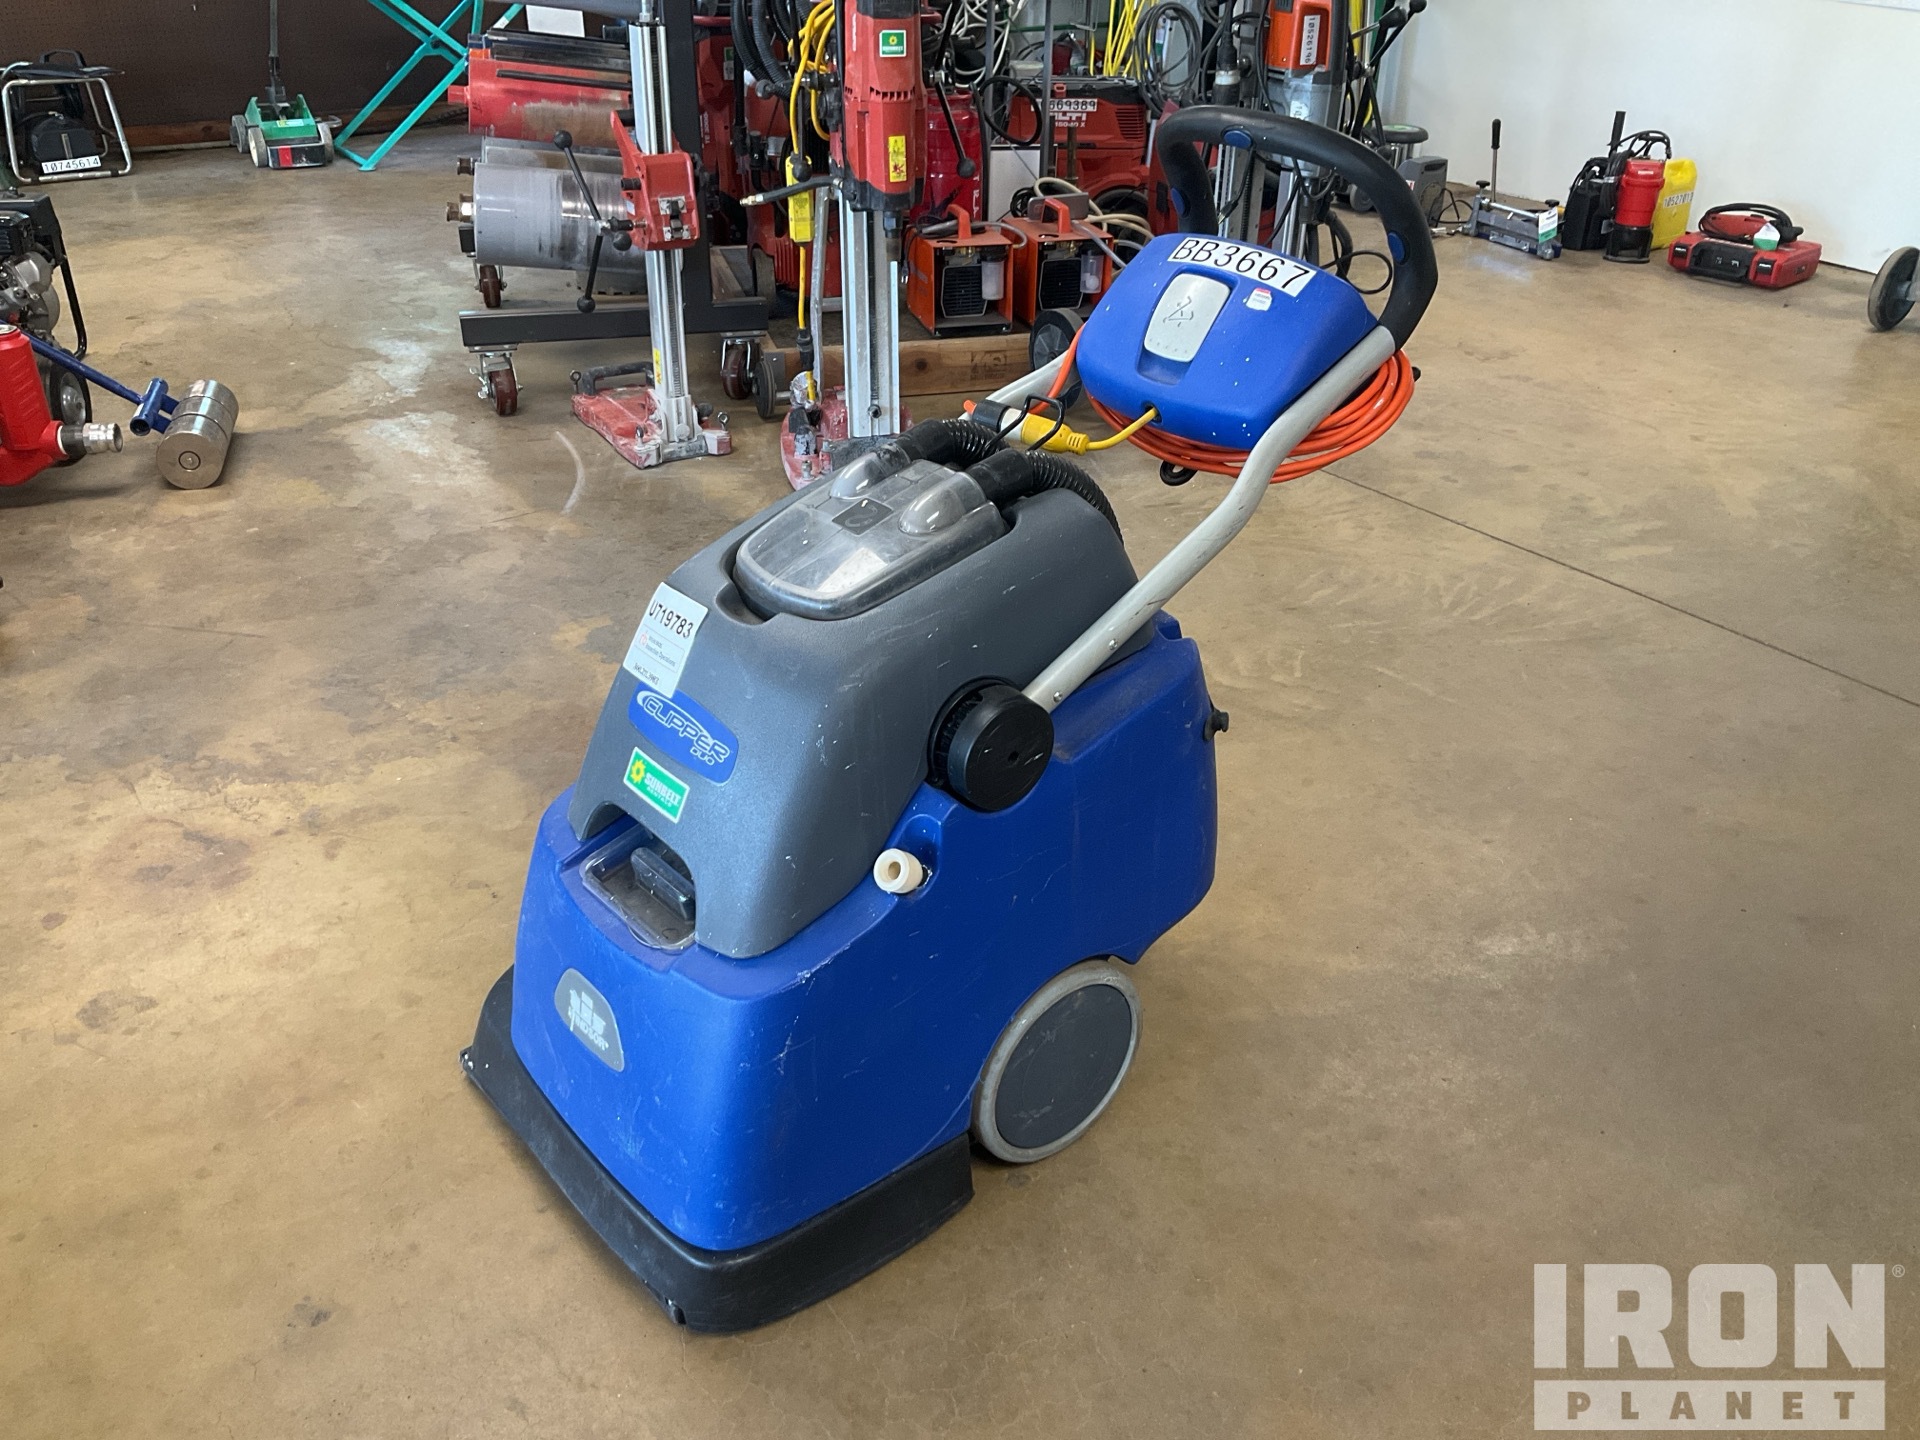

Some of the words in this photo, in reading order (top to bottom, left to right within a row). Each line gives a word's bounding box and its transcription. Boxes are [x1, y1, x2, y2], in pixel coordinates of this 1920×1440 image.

[1046, 100, 1096, 111] 669389
[44, 157, 99, 172] 10745614
[1172, 239, 1311, 290] BB3667
[649, 600, 694, 639] U719783
[643, 695, 731, 763] CLIPPER
[690, 746, 715, 766] DUO
[644, 771, 682, 807] SUNBELT
